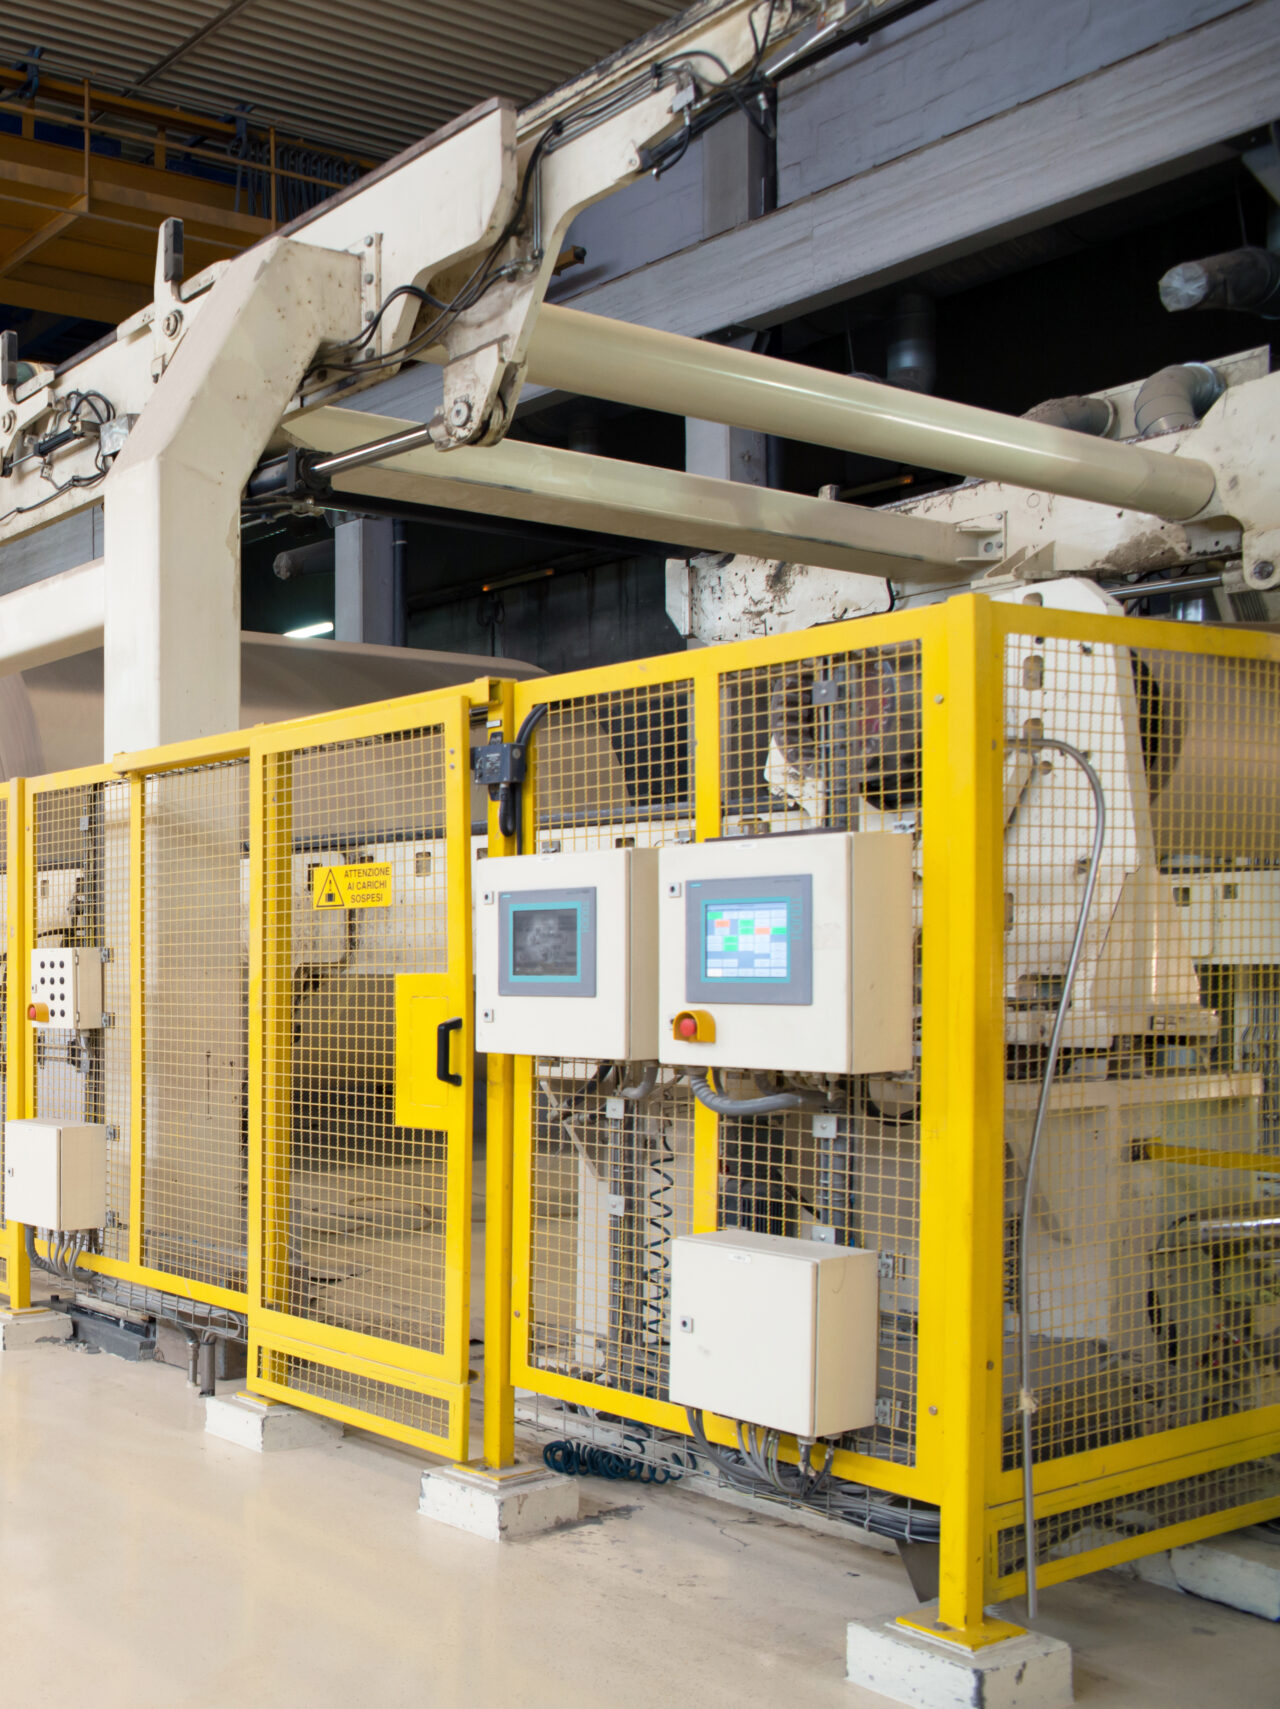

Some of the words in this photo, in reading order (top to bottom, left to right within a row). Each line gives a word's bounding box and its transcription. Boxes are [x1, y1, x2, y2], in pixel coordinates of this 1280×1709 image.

[344, 866, 391, 878] ATTENZIONE
[347, 882, 355, 890] AI
[356, 880, 387, 890] CARICHI
[350, 893, 384, 903] SOSPESI
